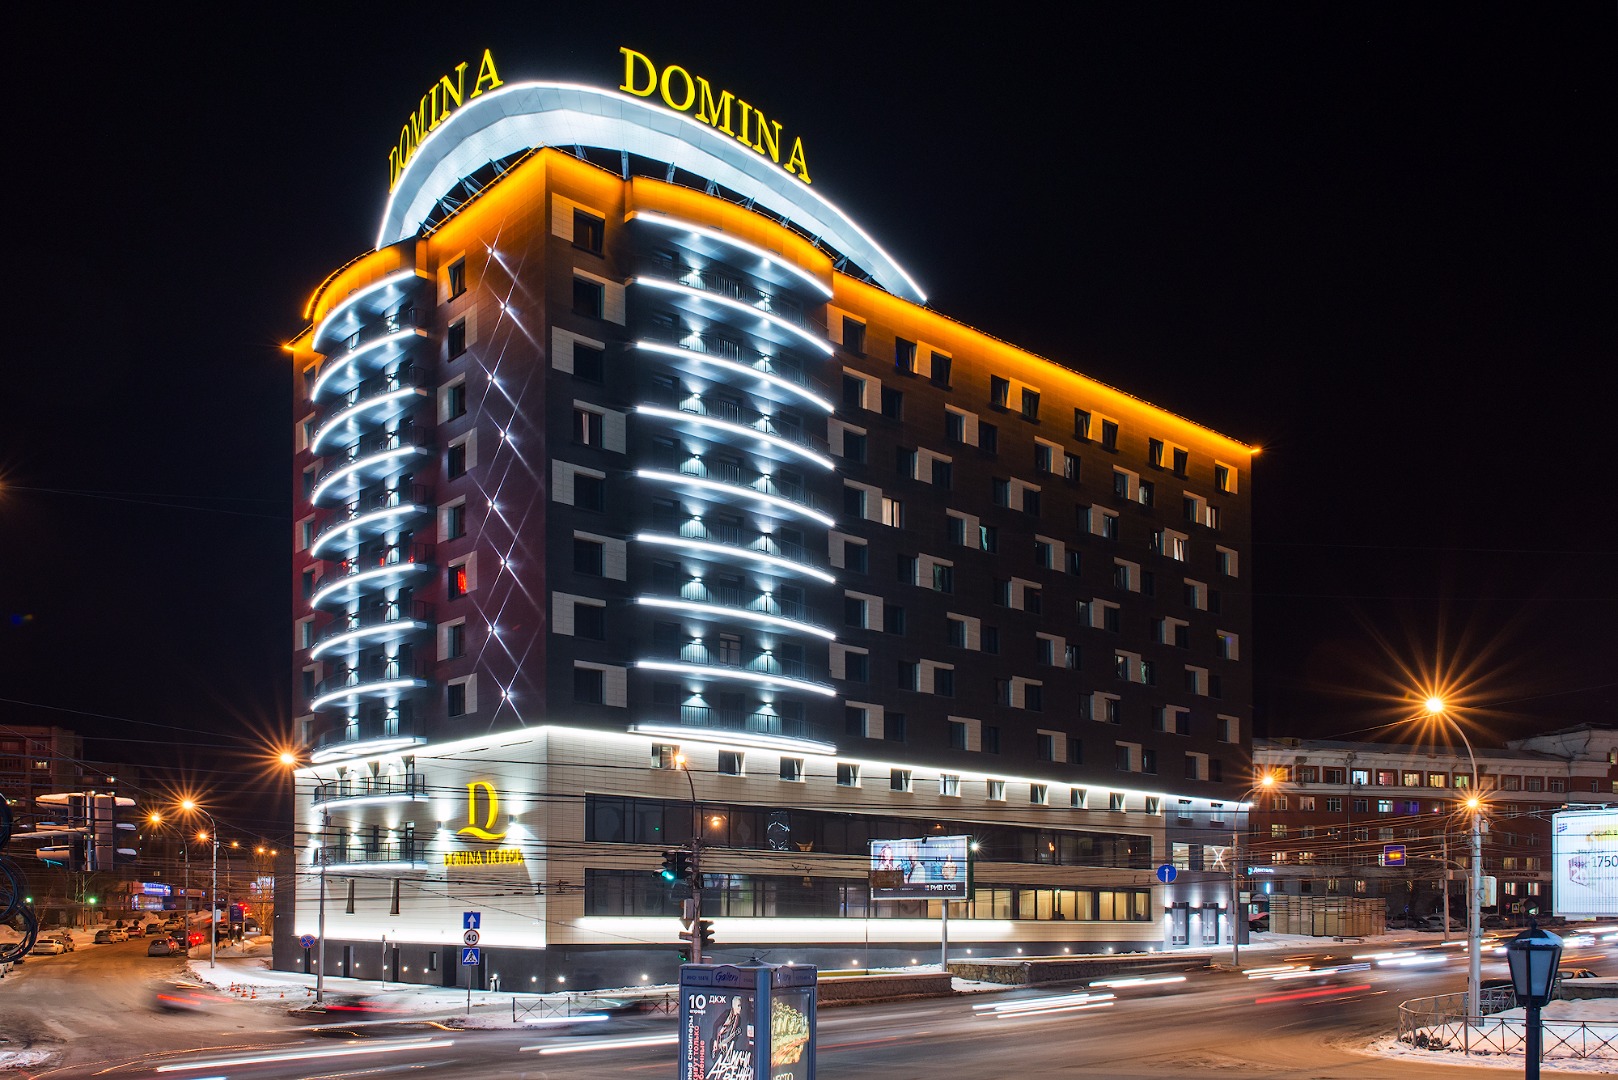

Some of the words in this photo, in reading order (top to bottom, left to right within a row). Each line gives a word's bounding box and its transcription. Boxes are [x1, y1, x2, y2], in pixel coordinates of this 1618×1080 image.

[388, 48, 505, 194] DOMINA
[619, 46, 812, 185] DOMINA
[443, 851, 483, 867] DOMINA
[466, 934, 477, 942] 40
[689, 994, 706, 1010] 10
